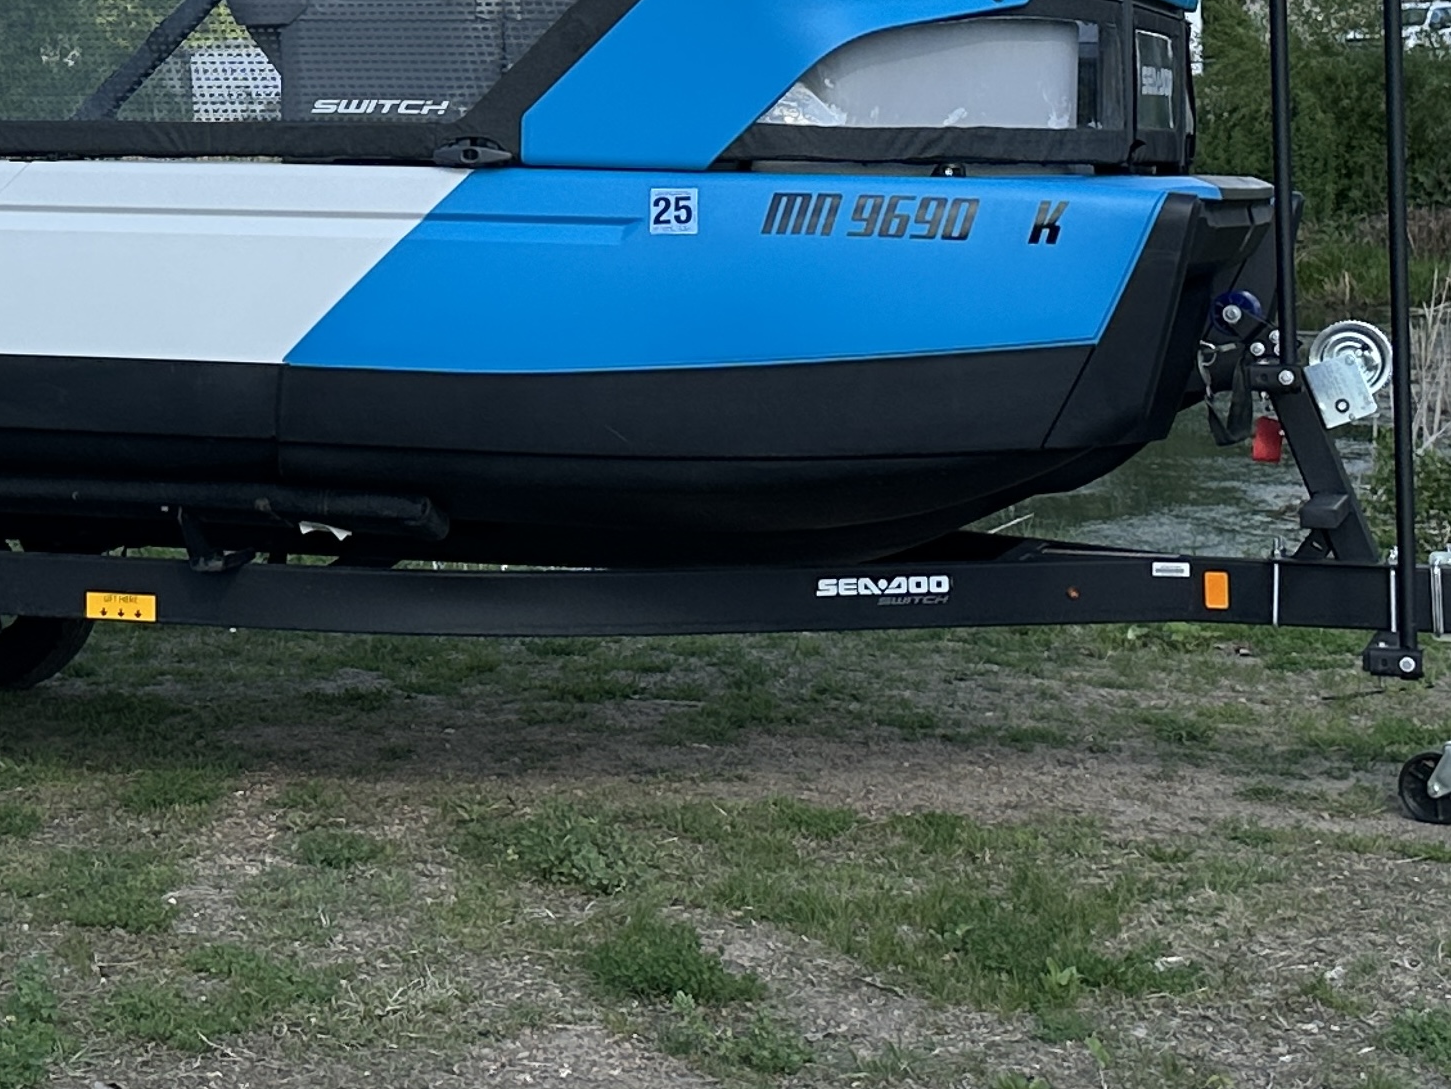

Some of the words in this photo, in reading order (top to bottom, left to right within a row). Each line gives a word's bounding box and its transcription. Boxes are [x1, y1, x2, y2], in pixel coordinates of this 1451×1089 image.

[311, 99, 450, 114] SWITCH
[653, 196, 693, 225] 25
[761, 192, 843, 236] MN
[846, 194, 980, 241] 9690
[1028, 199, 1070, 245] K
[876, 595, 950, 606] SWITCH
